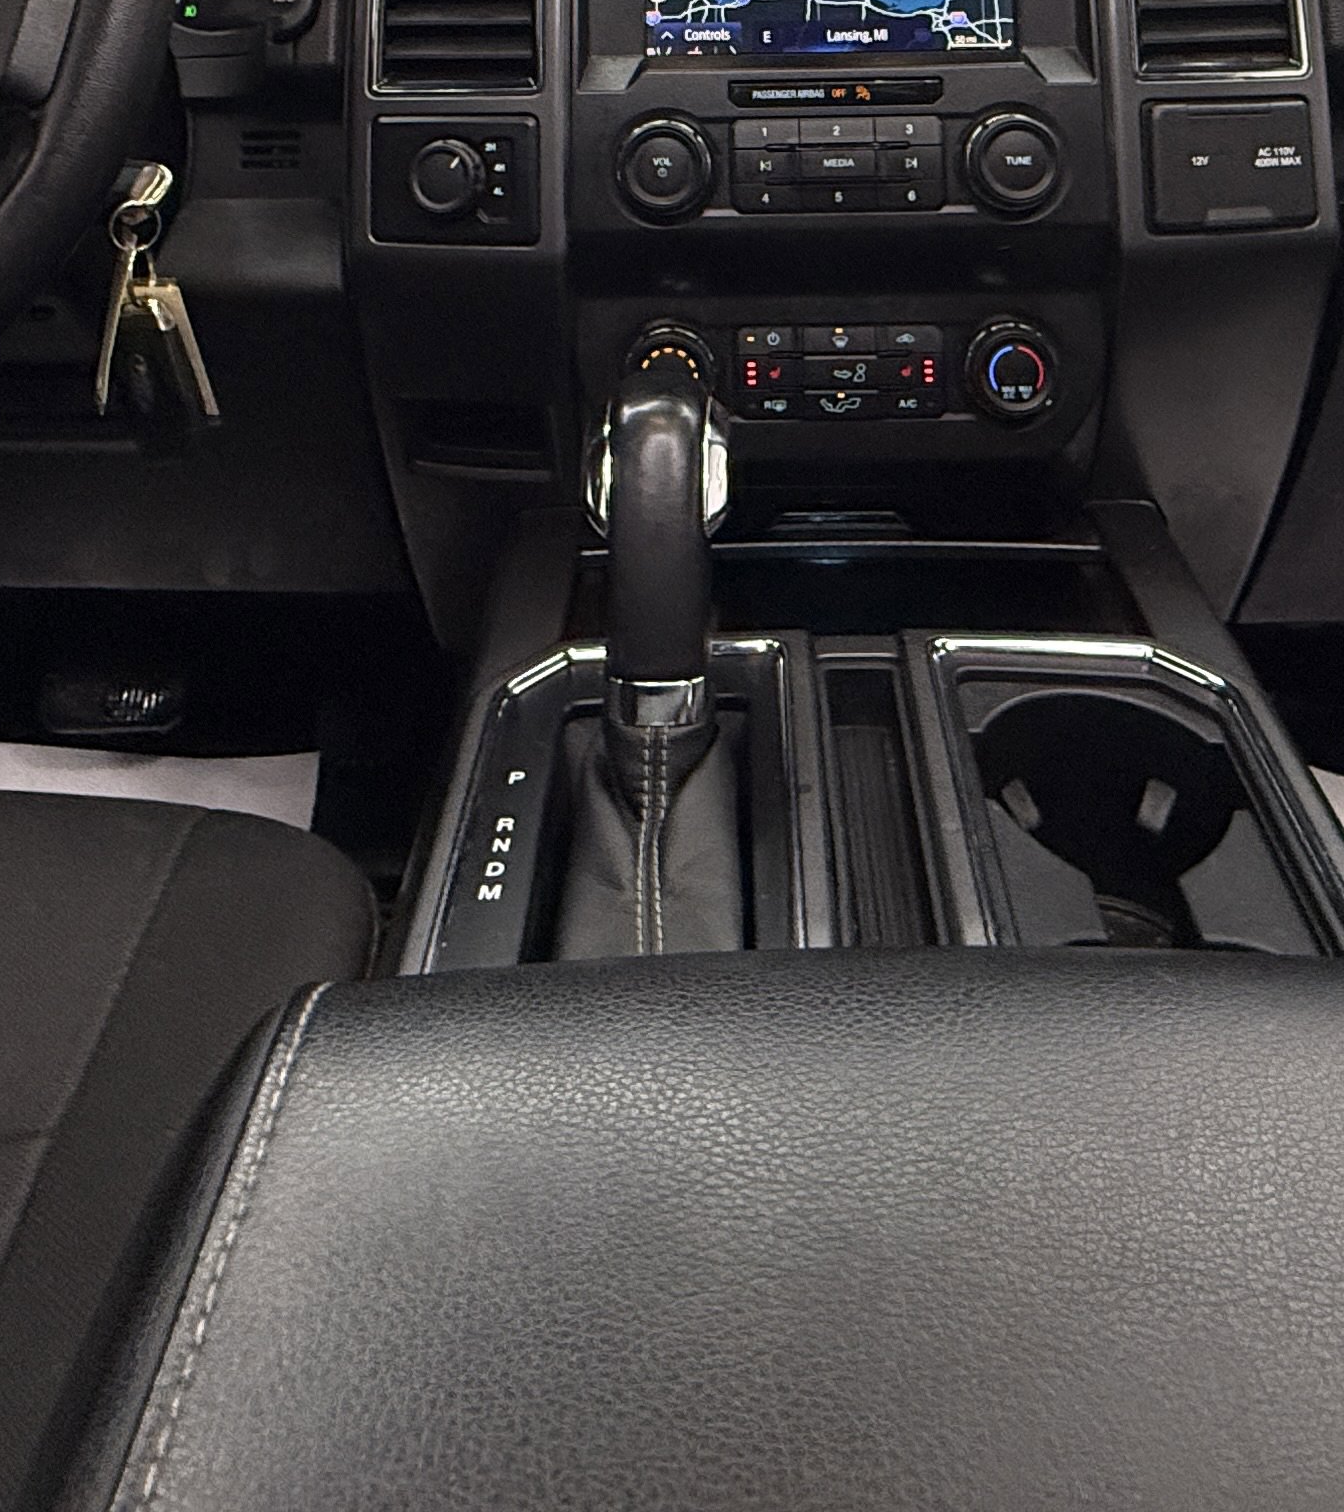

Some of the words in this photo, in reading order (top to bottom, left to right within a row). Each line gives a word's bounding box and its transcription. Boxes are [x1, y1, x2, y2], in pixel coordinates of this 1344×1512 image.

[684, 28, 731, 42] Controls
[763, 31, 771, 43] E
[826, 29, 872, 43] Lansing,
[874, 28, 888, 41] MI
[752, 90, 797, 99] PASSENGER
[798, 89, 825, 98] AIRBAG
[831, 88, 846, 98] OFF
[761, 127, 768, 137] 1
[832, 125, 841, 137] 2
[905, 123, 914, 136] 3
[1258, 147, 1272, 157] AC
[652, 157, 672, 167] VOL
[823, 158, 855, 168] MEDIA
[1005, 155, 1033, 166] TUNE
[1191, 155, 1209, 166] 12V
[1280, 155, 1302, 166] MAX
[762, 193, 770, 203] 4
[834, 191, 843, 202] 5
[907, 190, 916, 202] 6
[898, 399, 918, 409] A/C
[508, 771, 526, 785] P
[496, 817, 515, 832] R
[492, 838, 511, 853] N
[485, 862, 505, 877] D
[477, 884, 503, 900] M
